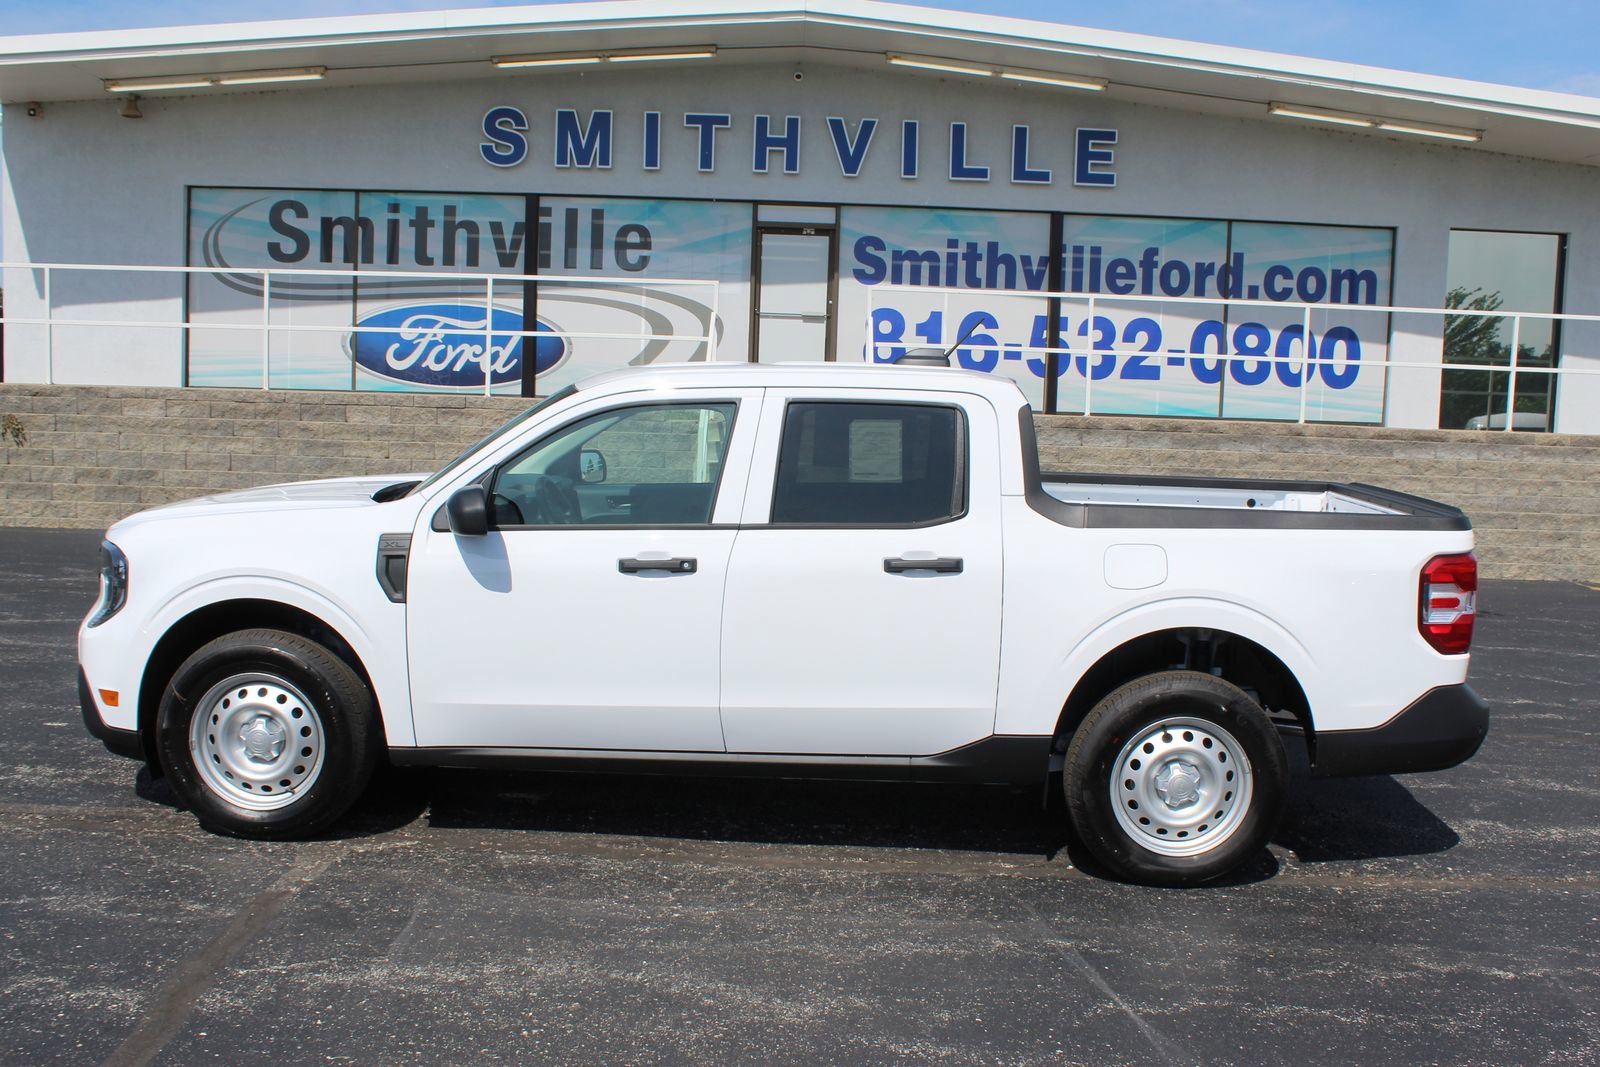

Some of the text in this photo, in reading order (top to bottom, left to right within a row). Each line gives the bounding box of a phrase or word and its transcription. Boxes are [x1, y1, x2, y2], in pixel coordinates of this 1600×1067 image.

[480, 105, 1119, 187] SMITHVILLE
[267, 199, 652, 272] Smithville
[385, 314, 521, 374] Ford
[863, 307, 1361, 389] 816-532-0800
